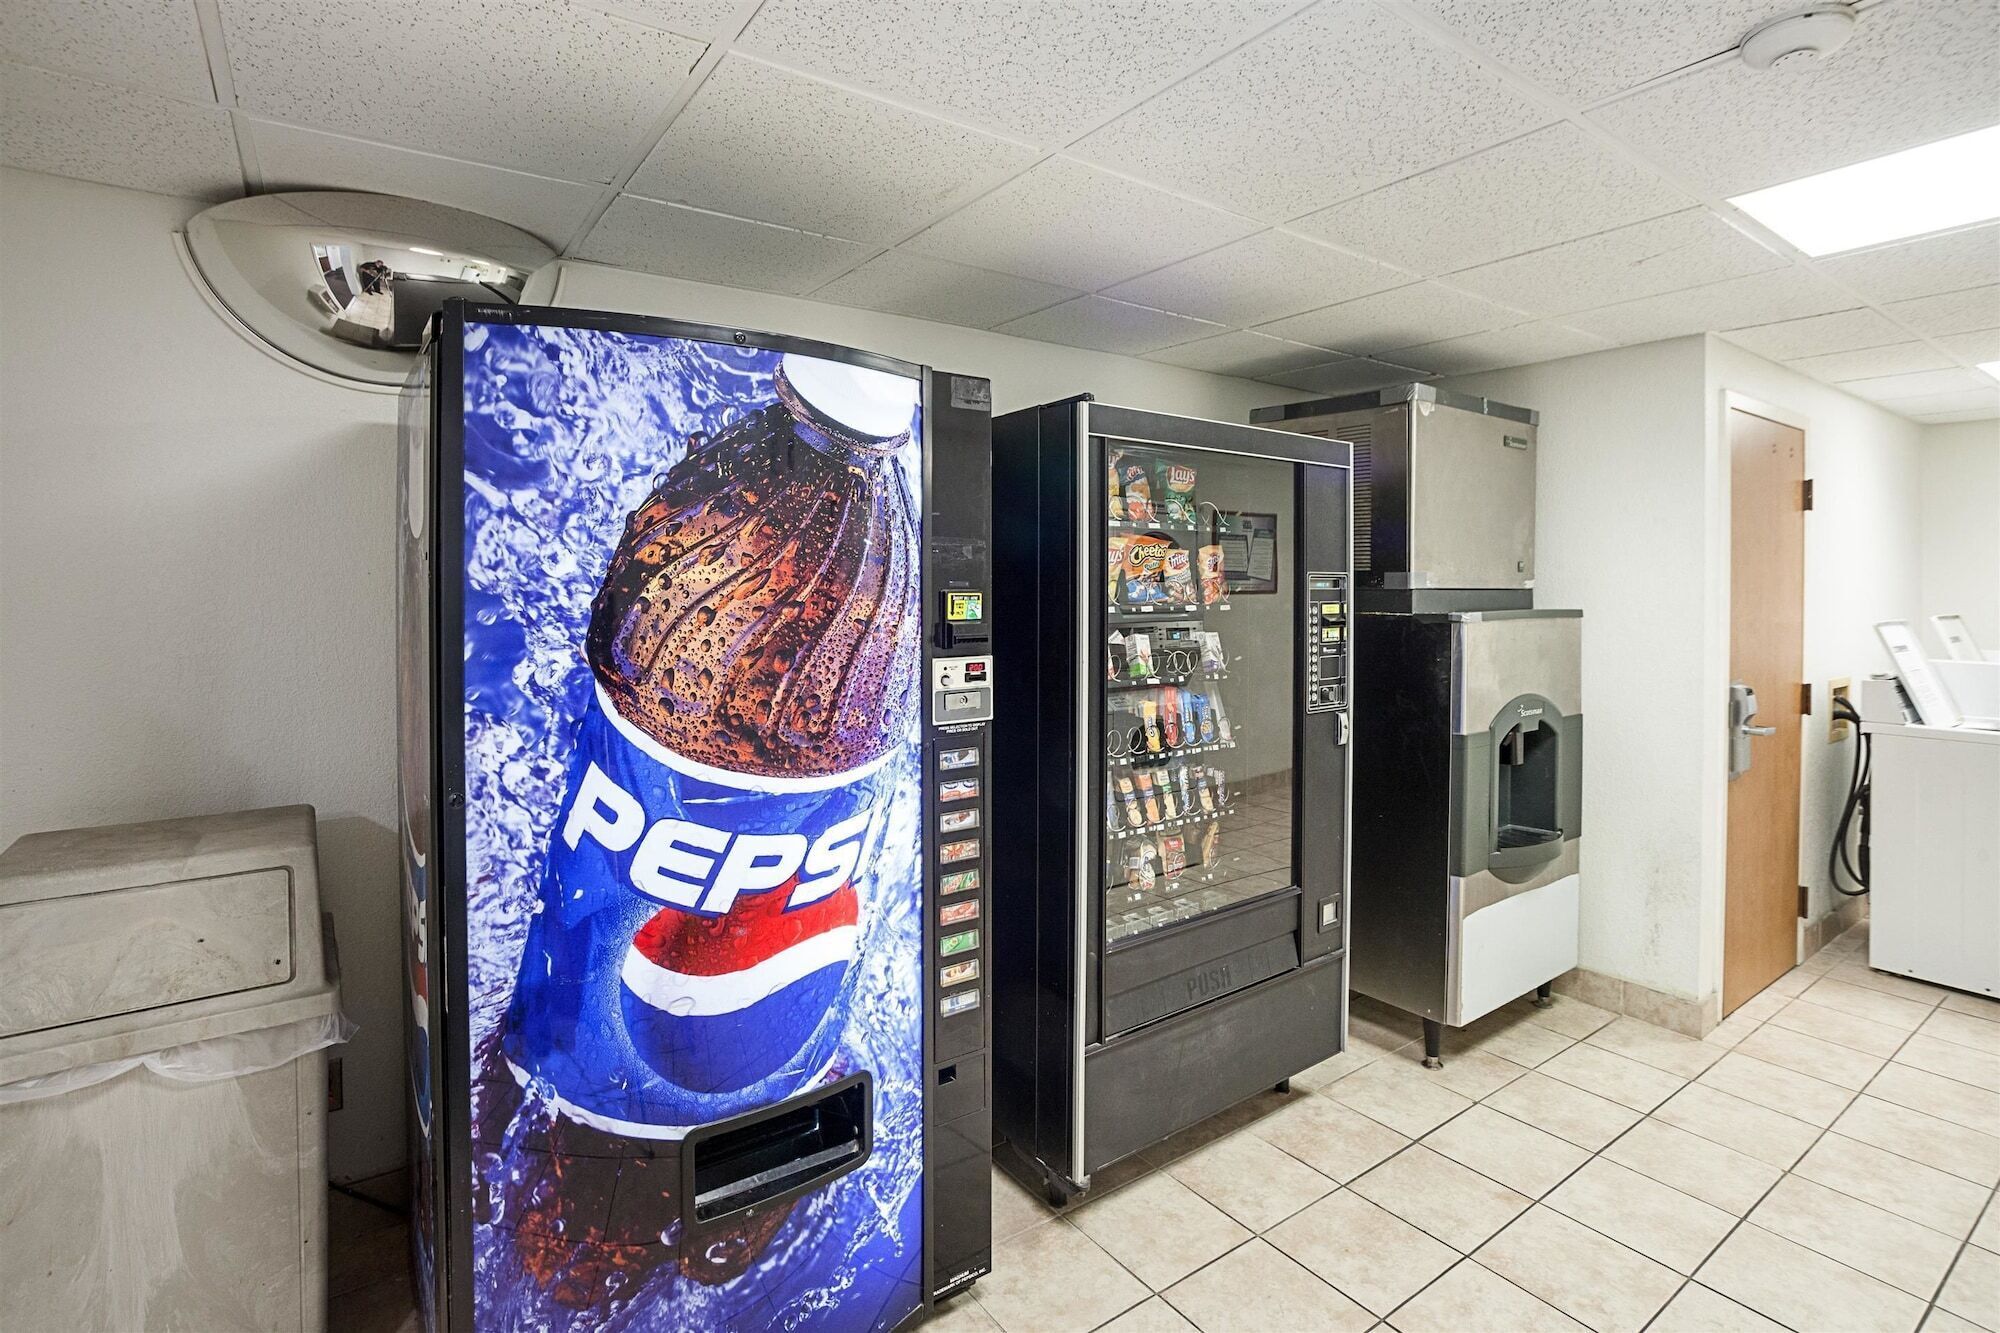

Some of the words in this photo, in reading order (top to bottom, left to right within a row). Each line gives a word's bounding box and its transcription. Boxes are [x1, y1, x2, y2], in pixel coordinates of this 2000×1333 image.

[1170, 466, 1195, 484] Lay's
[1130, 543, 1167, 566] Cheetos
[562, 760, 884, 914] PEPSI
[1187, 965, 1231, 1000] PUSH
